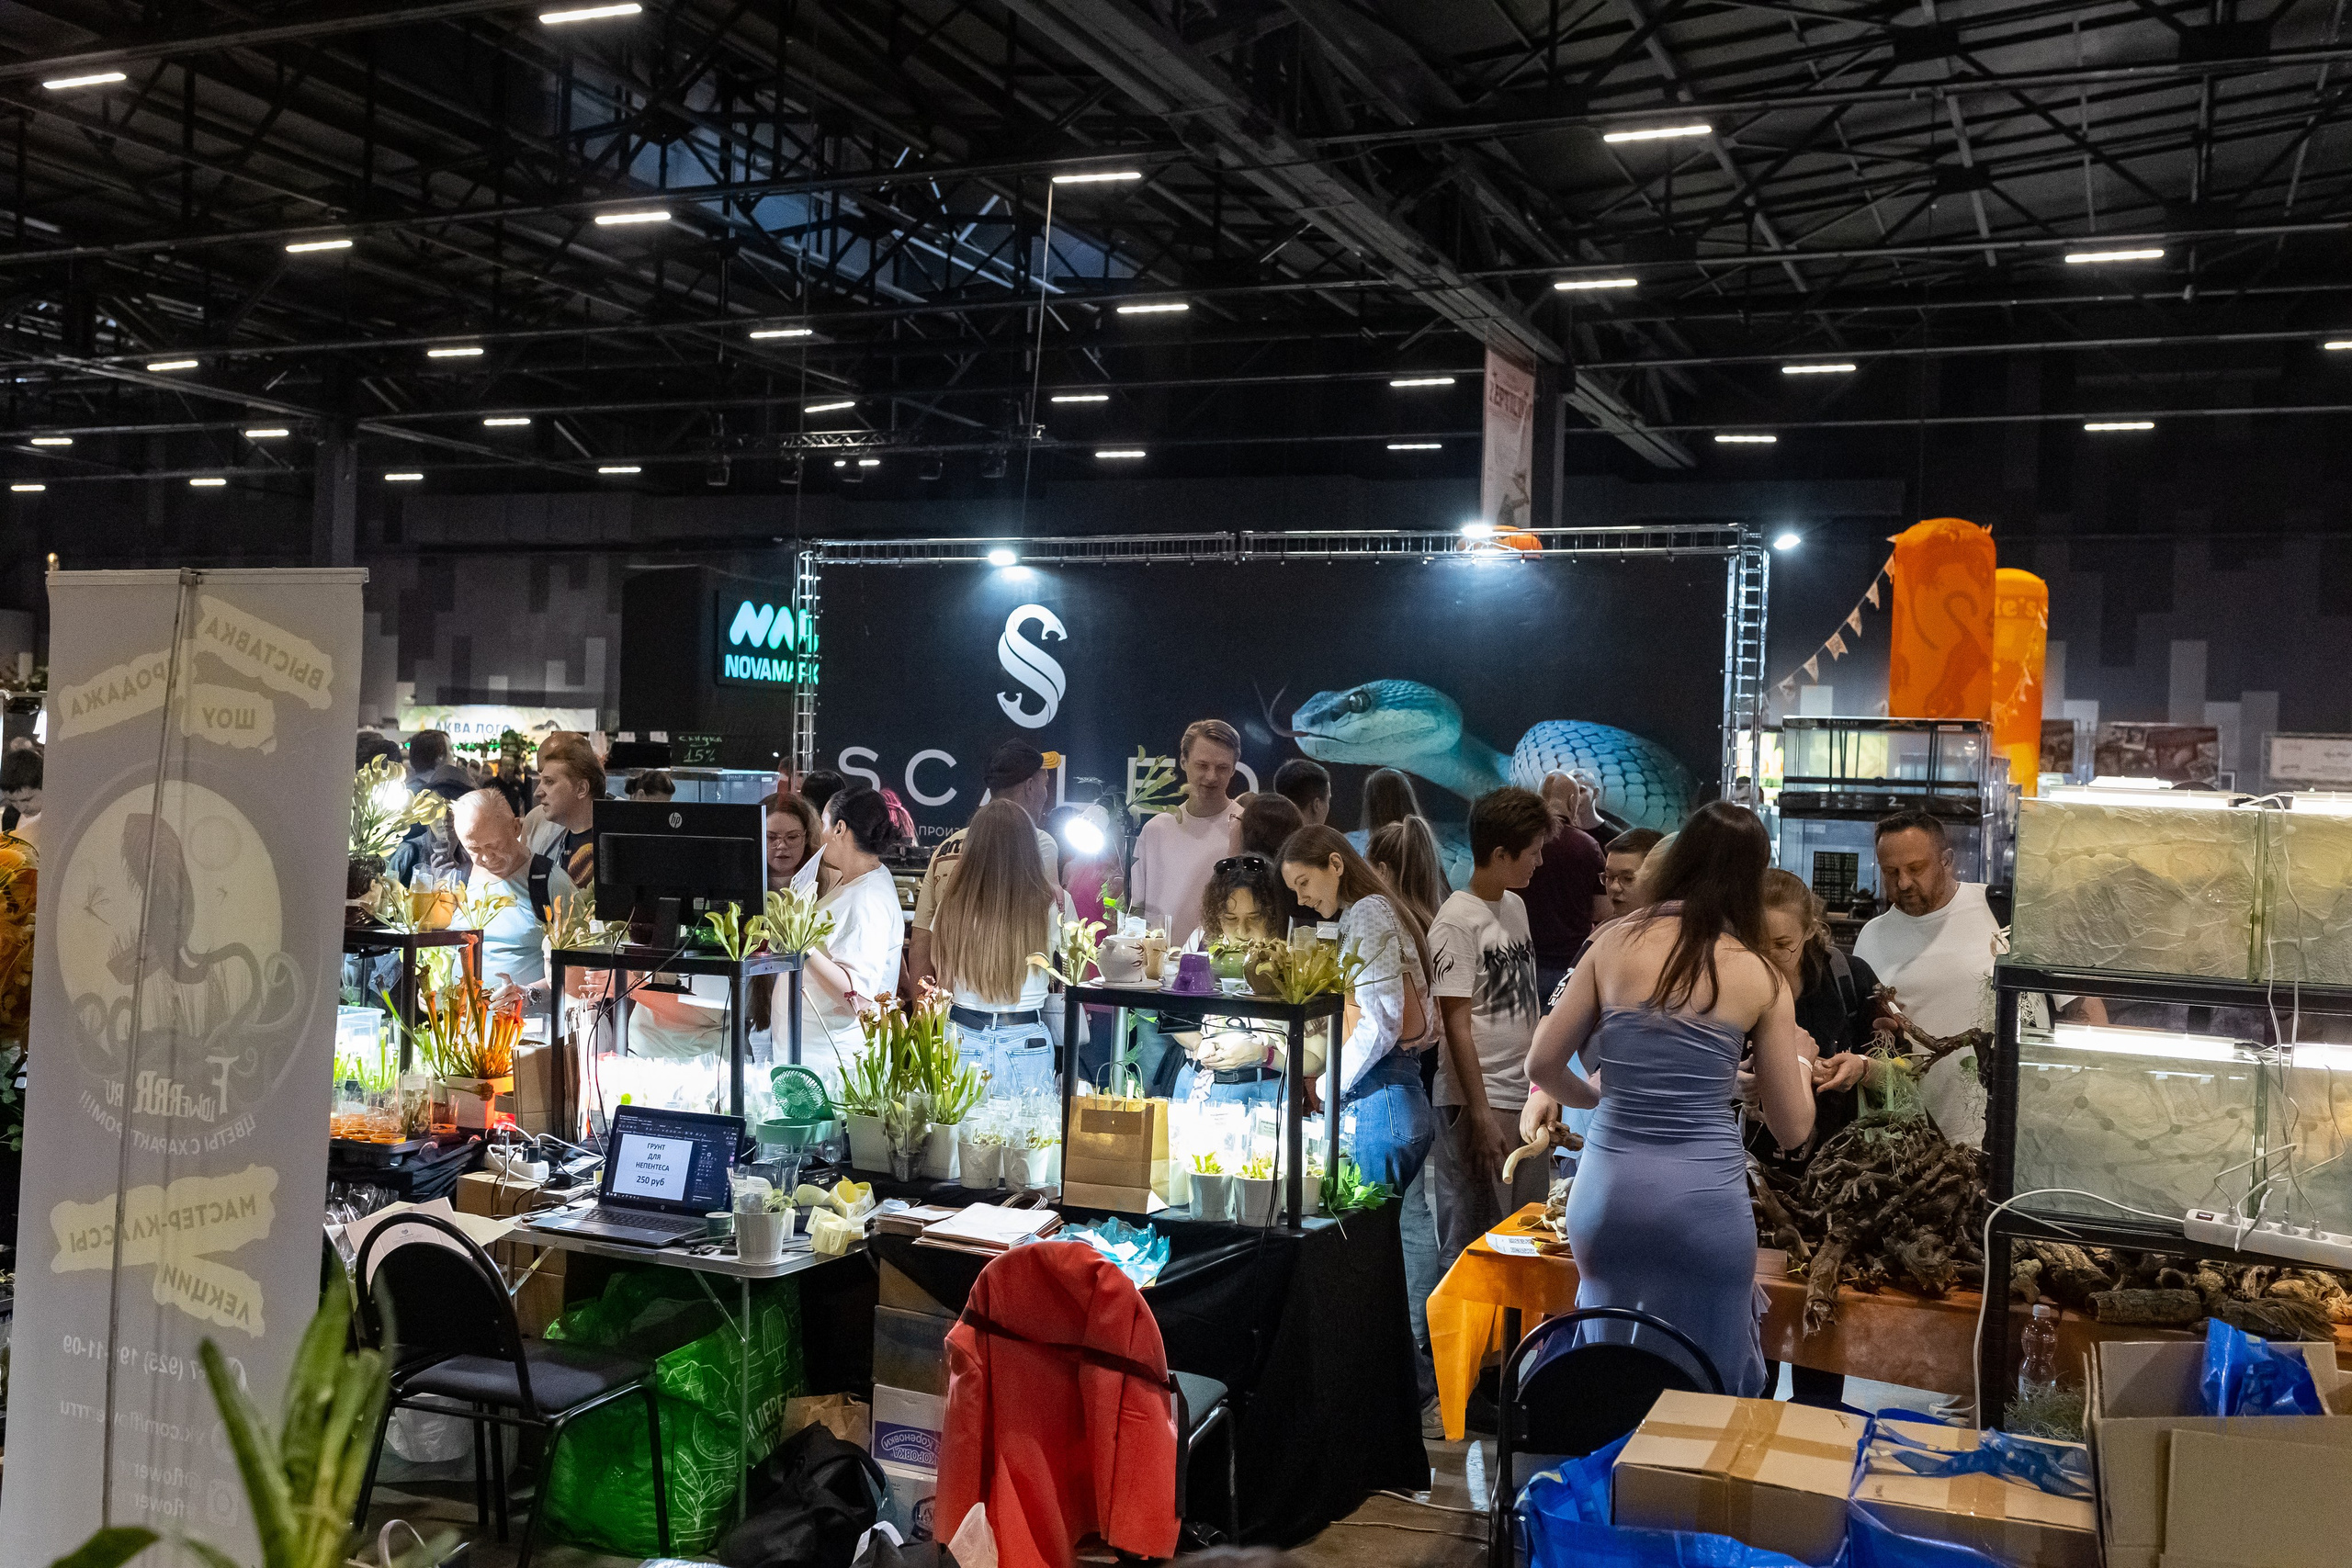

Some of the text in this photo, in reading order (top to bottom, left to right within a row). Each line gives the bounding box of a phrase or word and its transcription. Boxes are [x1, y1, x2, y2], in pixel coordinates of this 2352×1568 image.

[435, 721, 470, 733] АКВА
[683, 749, 716, 762] 15%
[838, 746, 1259, 815] SCLE
[647, 1143, 666, 1151] ГРУНТ
[635, 1161, 670, 1171] НЕПЕНТЕСА
[636, 1176, 665, 1187] 250 руб
[893, 1447, 936, 1464] КОРОВКА
